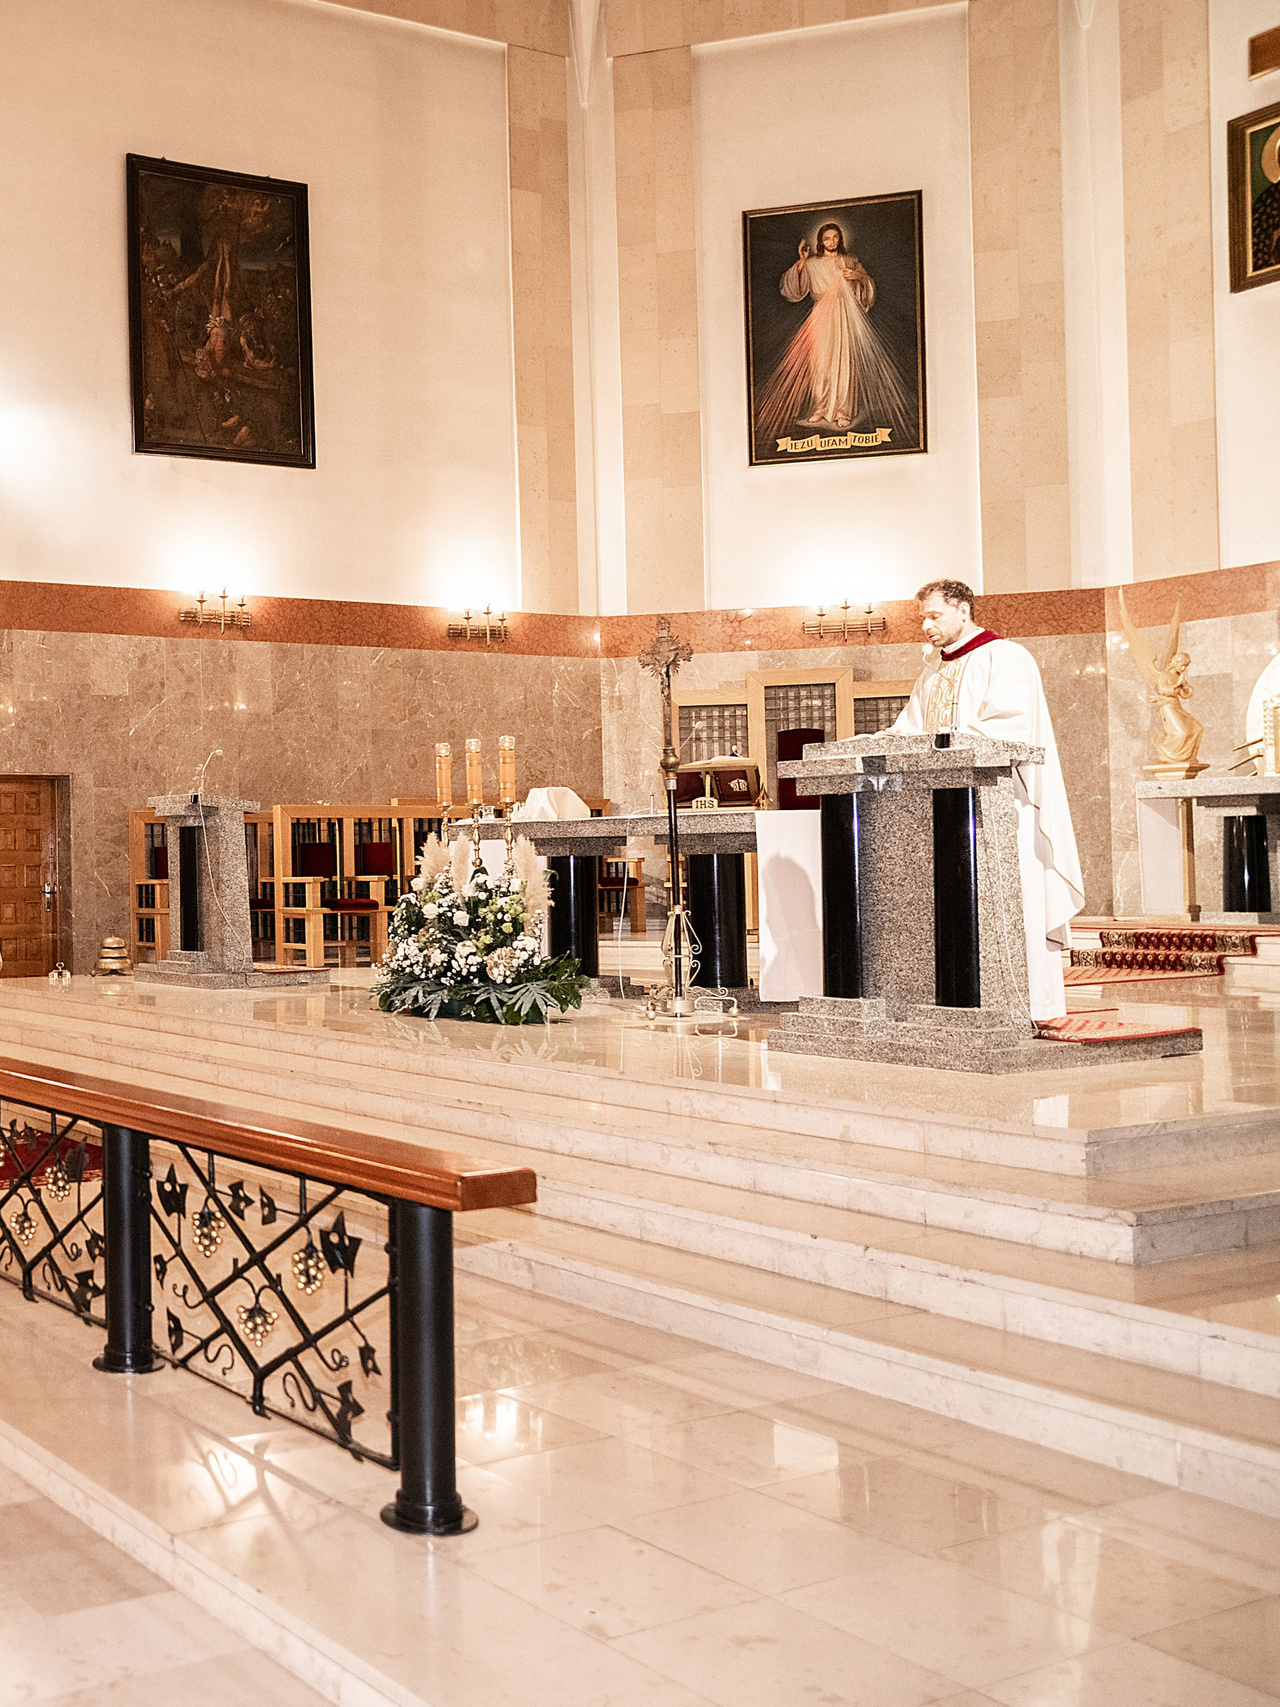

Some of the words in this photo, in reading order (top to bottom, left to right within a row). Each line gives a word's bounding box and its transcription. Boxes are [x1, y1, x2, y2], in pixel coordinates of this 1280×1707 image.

[790, 438, 813, 450] JEZU
[820, 437, 848, 448] UFAM
[852, 434, 880, 444] TOBIE
[695, 800, 715, 809] IHS
